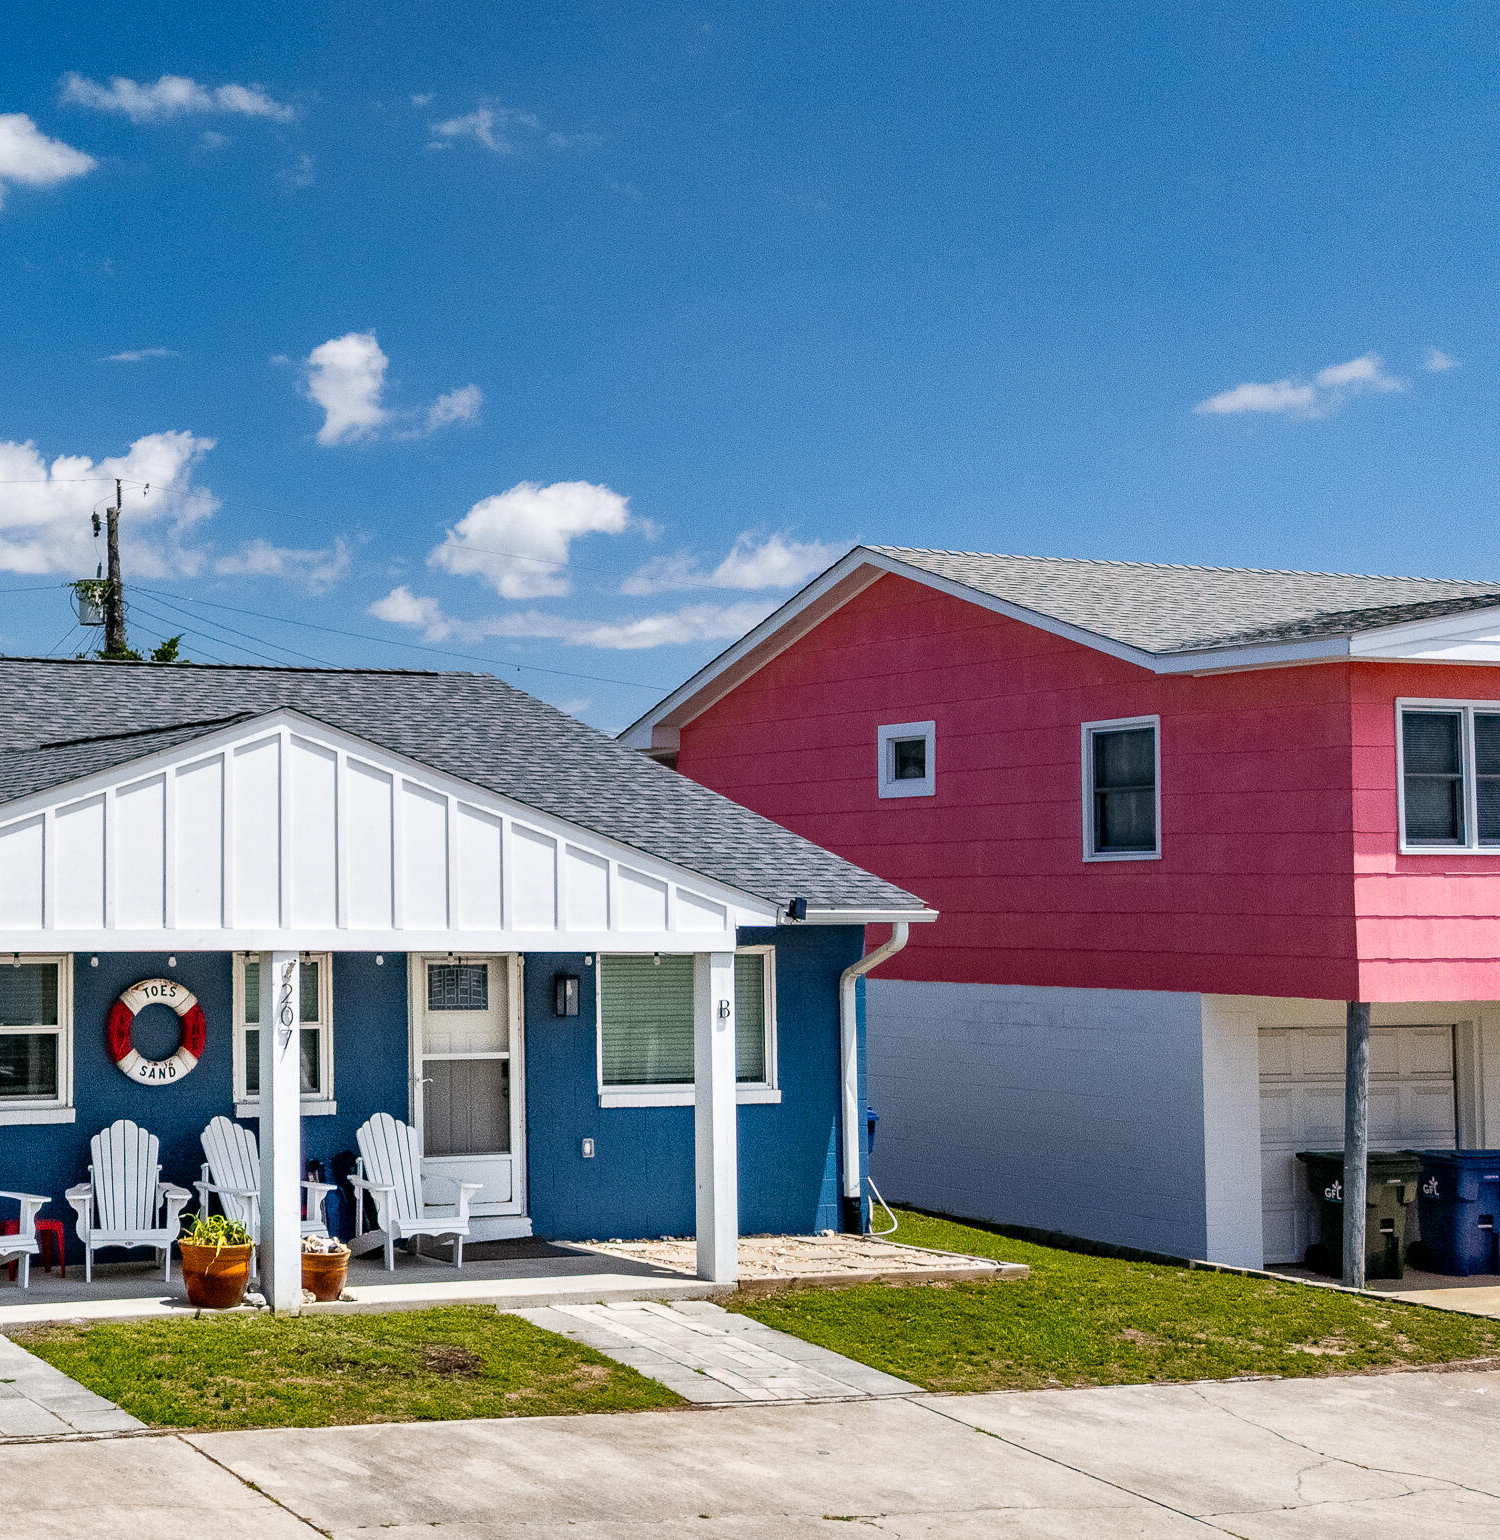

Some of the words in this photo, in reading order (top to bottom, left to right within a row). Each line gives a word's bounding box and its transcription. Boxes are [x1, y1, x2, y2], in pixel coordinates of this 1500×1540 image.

[143, 985, 177, 998] TOES
[719, 999, 731, 1019] B
[140, 1066, 176, 1079] SAND
[1324, 1183, 1342, 1200] GFL
[1423, 1179, 1440, 1196] GFL
